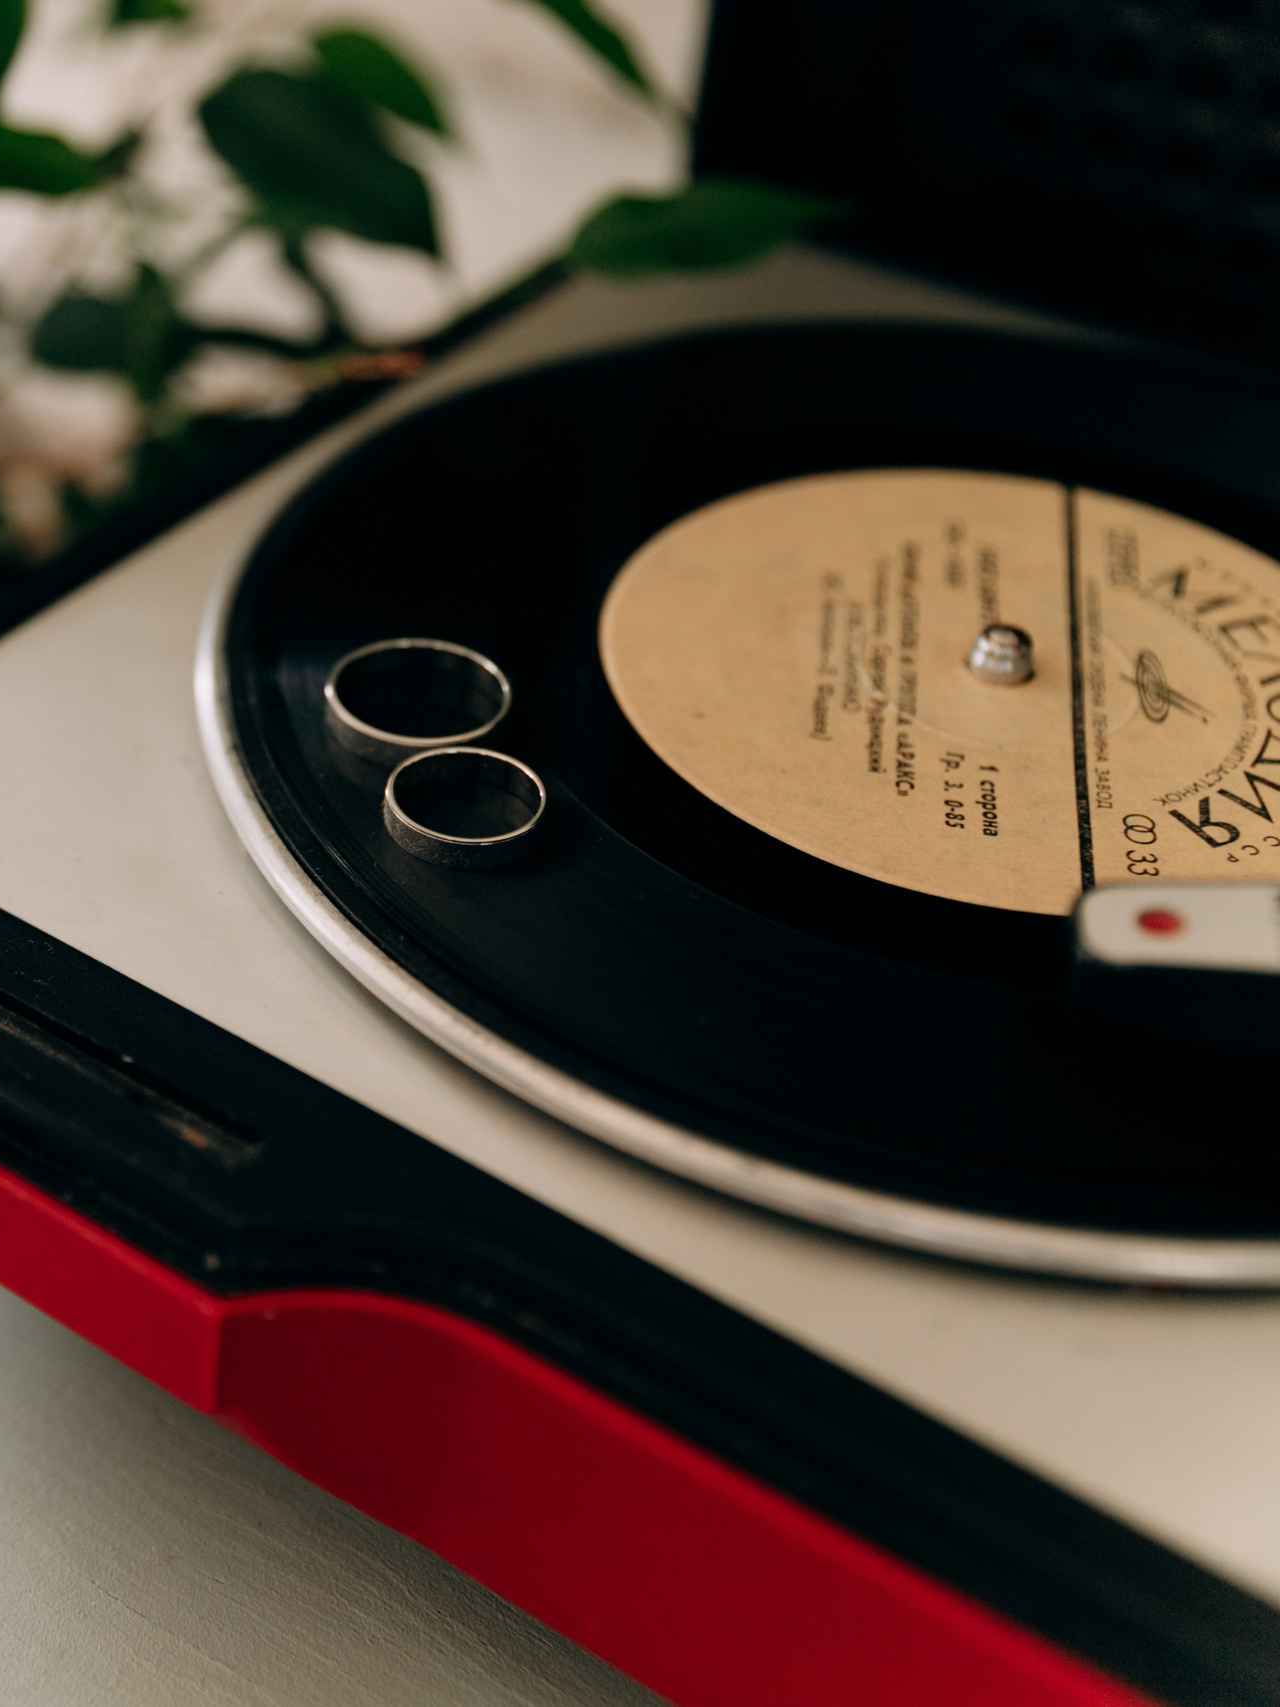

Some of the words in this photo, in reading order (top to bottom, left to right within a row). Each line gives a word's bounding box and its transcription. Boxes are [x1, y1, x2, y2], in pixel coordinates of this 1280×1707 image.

[1092, 714, 1109, 763] ЛЕНИНА
[895, 731, 916, 797] «АРАКС»
[940, 752, 966, 774] Гр.
[978, 765, 1000, 773] 1
[975, 779, 1000, 837] сторона
[1093, 767, 1113, 809] ЗАВОД
[943, 799, 966, 830] 0-85
